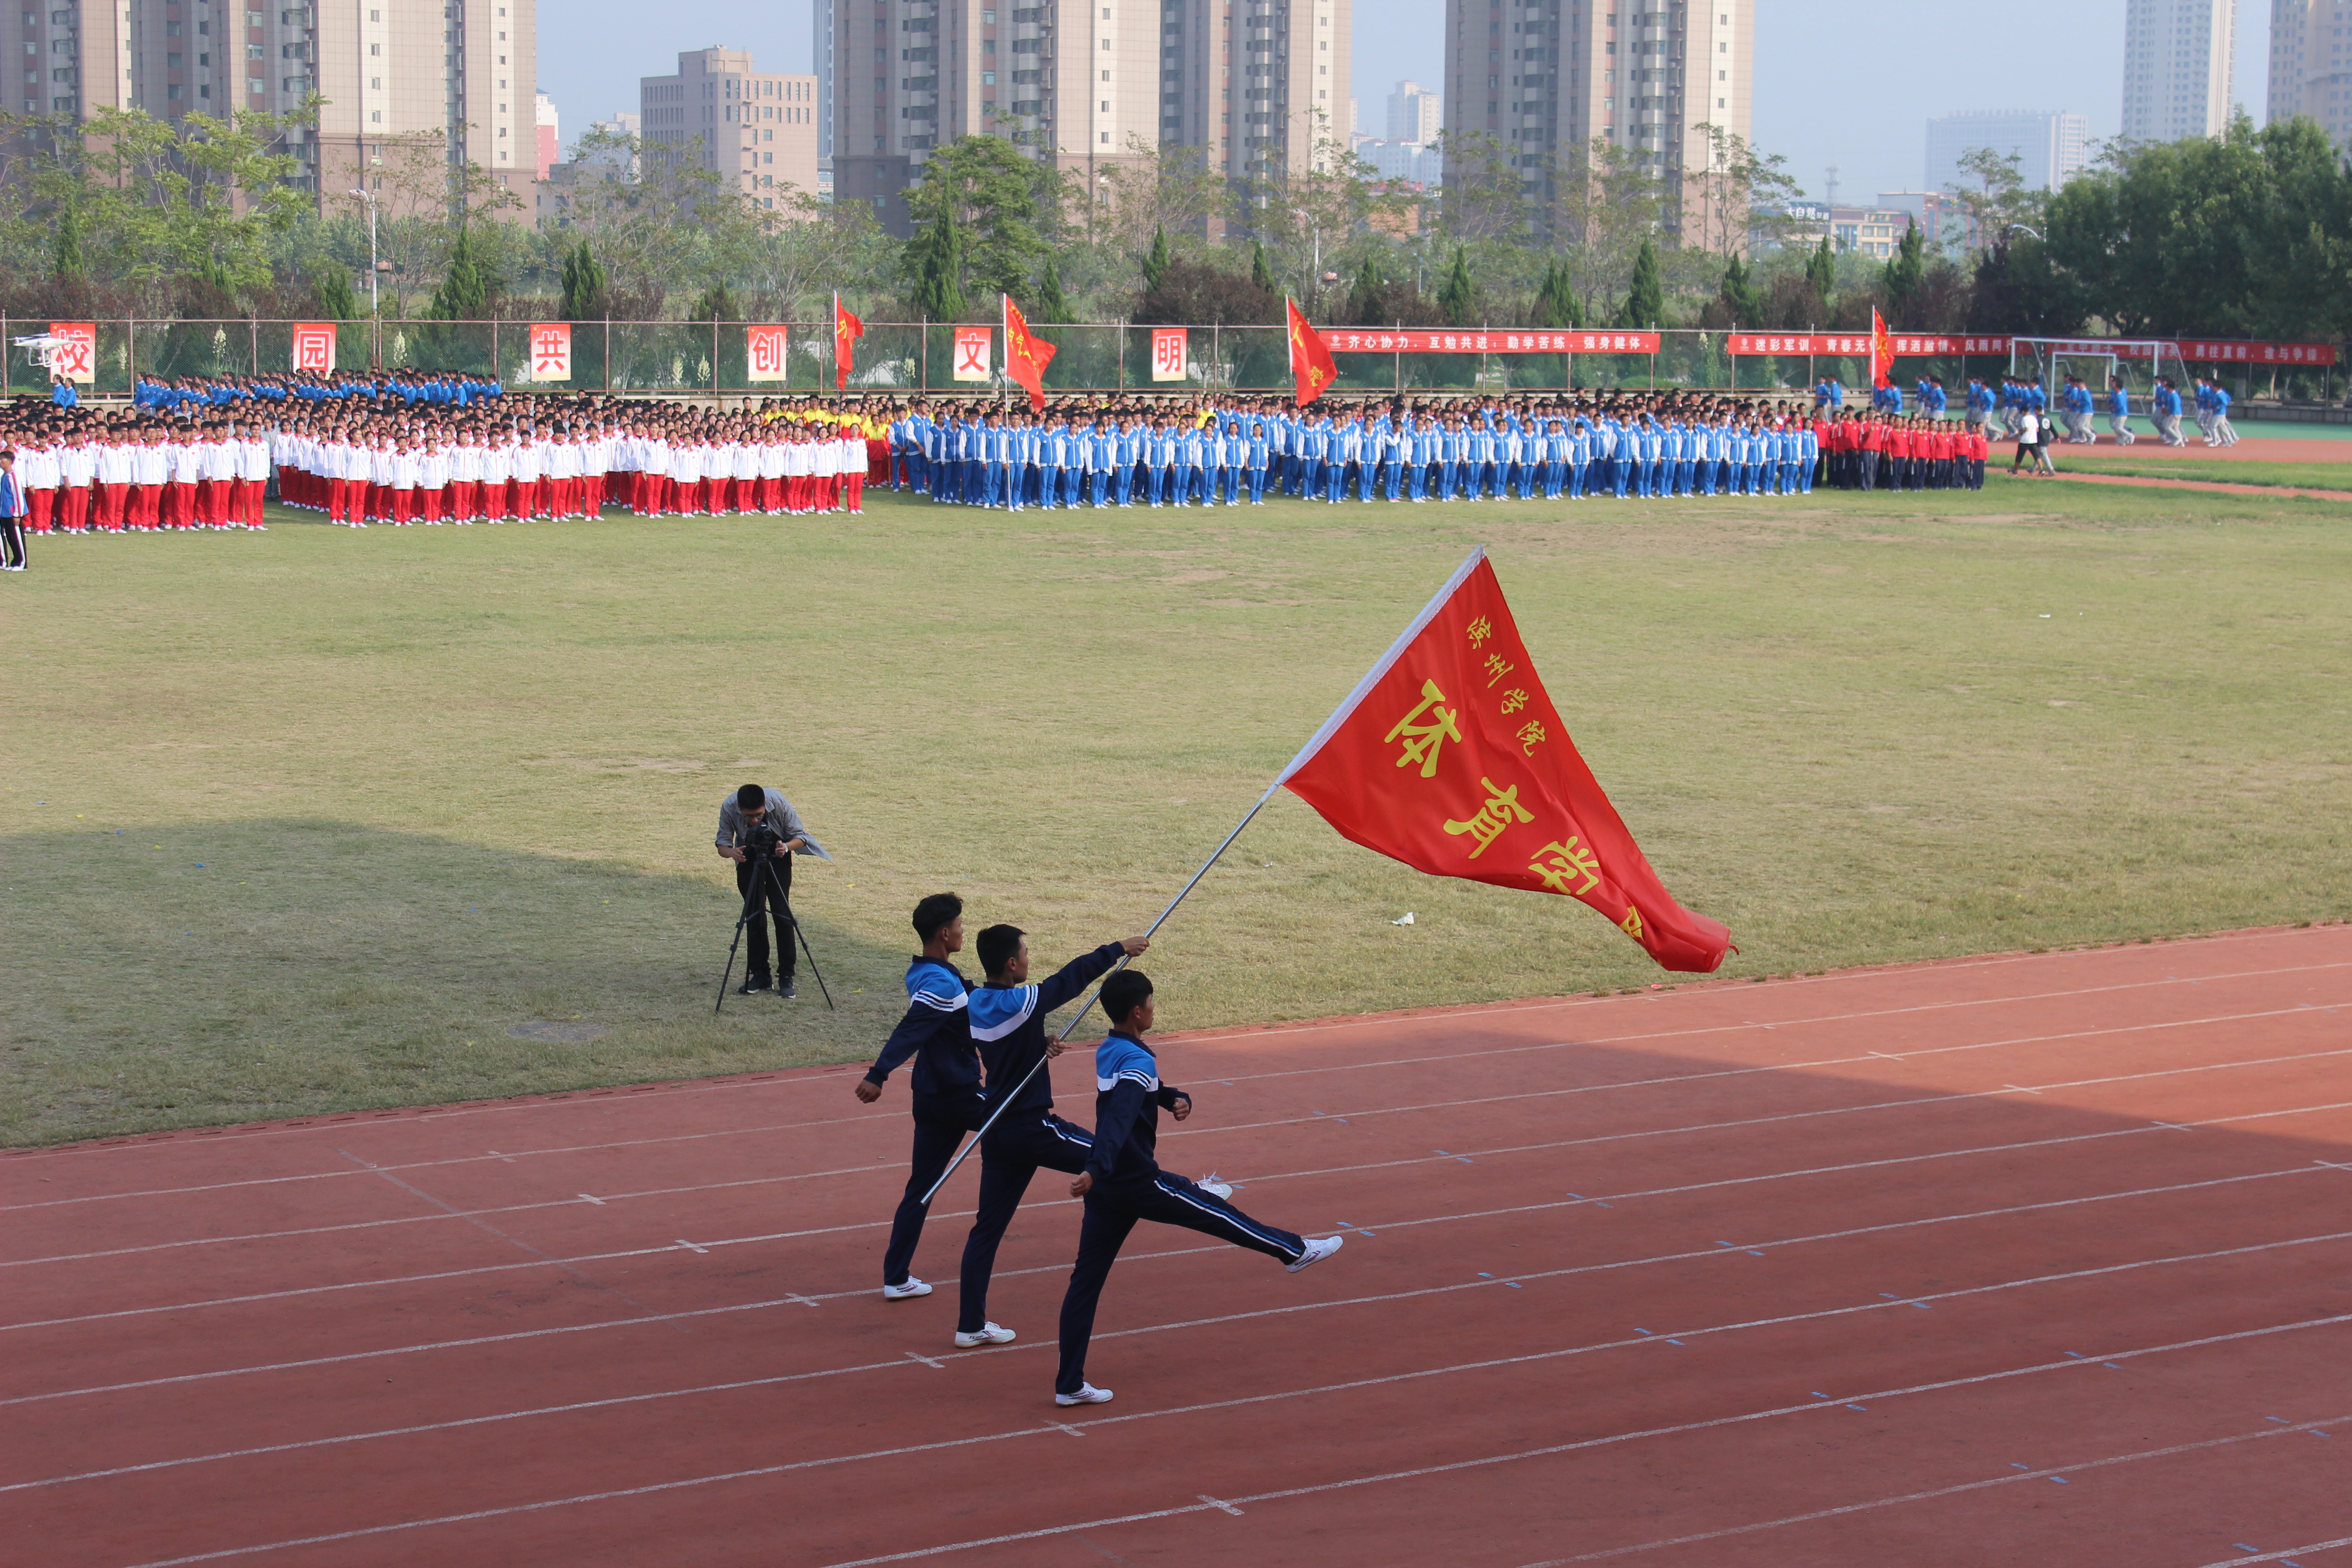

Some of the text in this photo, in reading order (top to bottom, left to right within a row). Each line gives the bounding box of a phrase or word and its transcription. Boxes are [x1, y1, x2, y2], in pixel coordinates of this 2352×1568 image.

[55, 330, 91, 375] 校
[299, 331, 330, 372] 园
[536, 331, 566, 372] 共
[752, 332, 781, 373] 创
[958, 333, 987, 373] 文
[1156, 336, 1182, 373] 明
[1466, 614, 1546, 757] 滨州学院
[1384, 678, 1645, 944] 体育学
